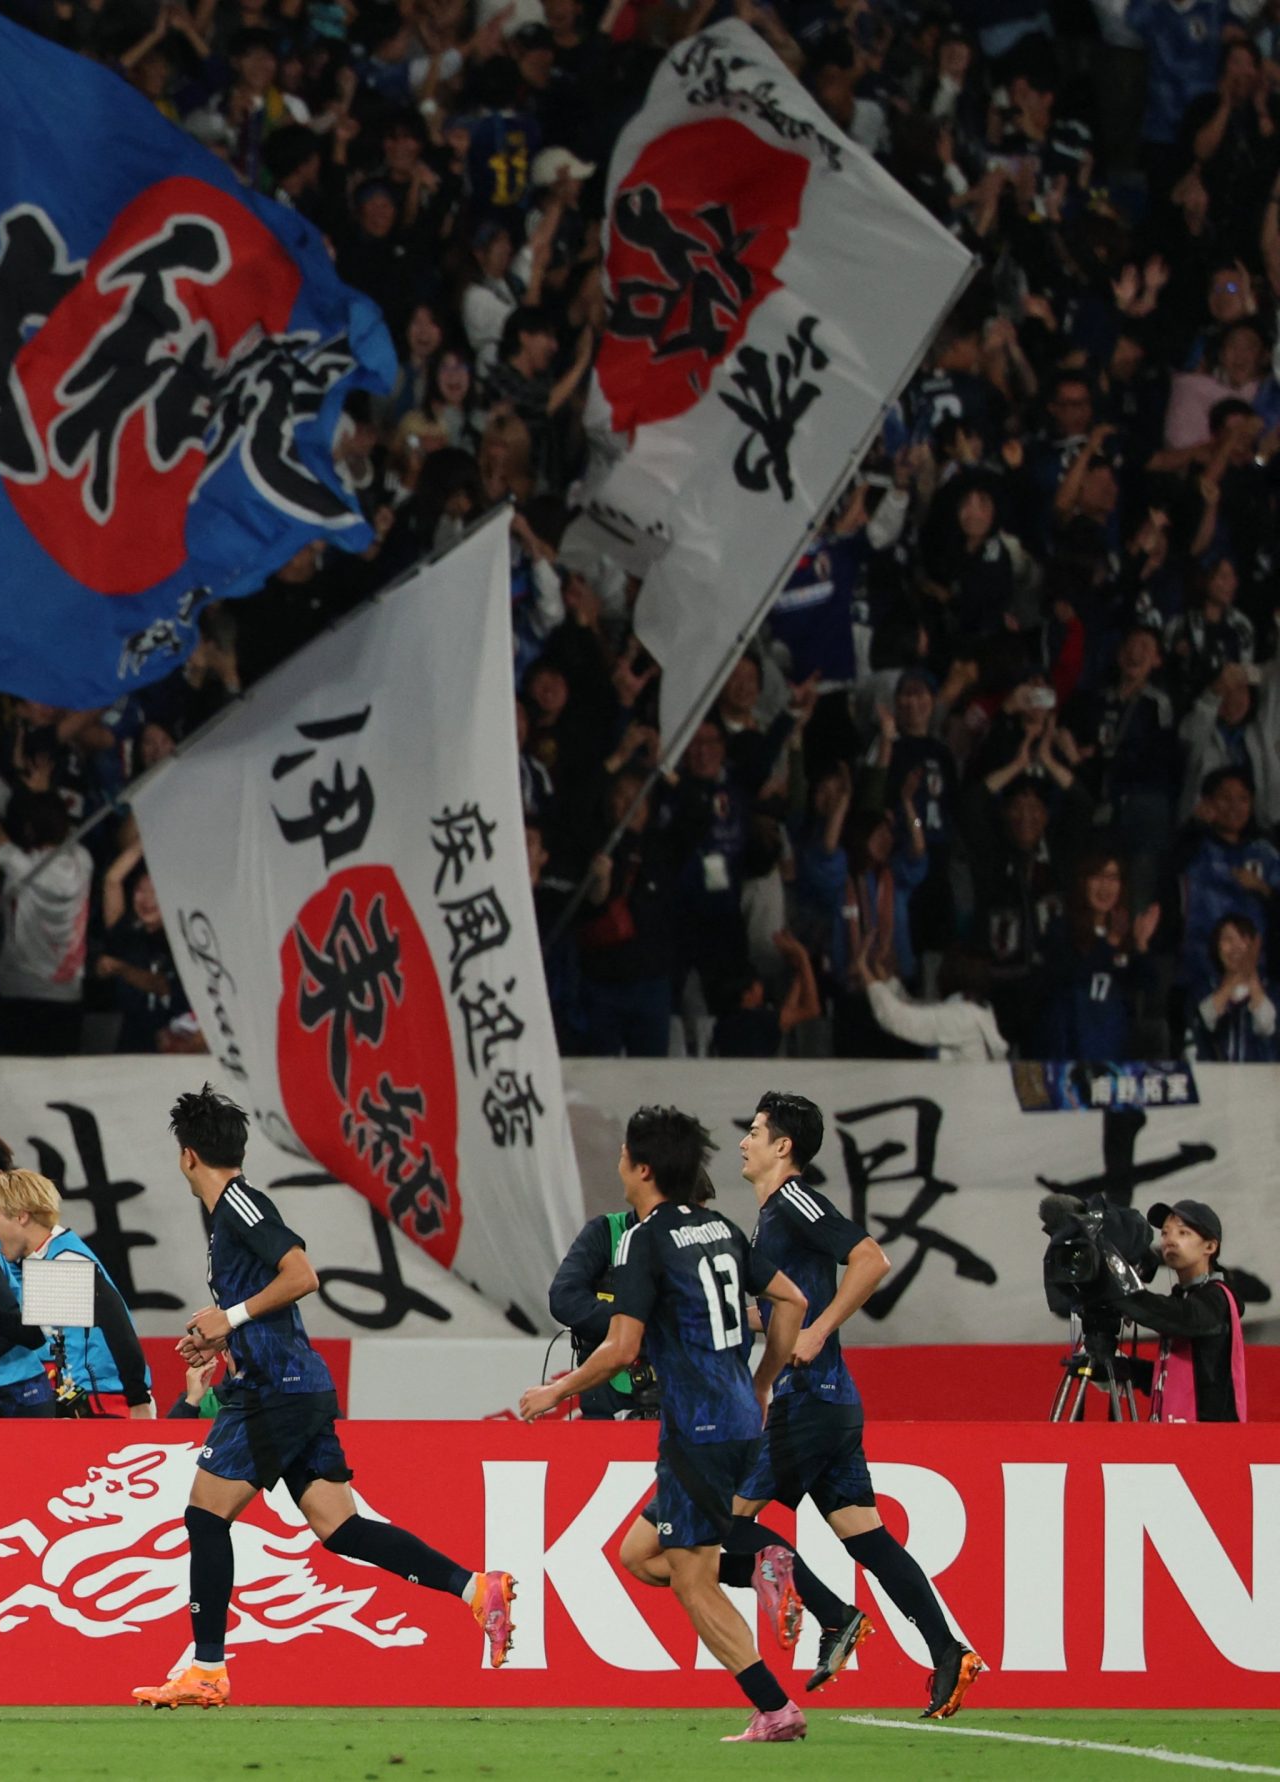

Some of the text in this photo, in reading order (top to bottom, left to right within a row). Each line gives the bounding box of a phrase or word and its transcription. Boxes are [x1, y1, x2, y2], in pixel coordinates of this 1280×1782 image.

[270, 703, 451, 1240] 伊東純
[430, 801, 546, 1148] 疾風迅雷
[697, 1252, 744, 1352] 13
[482, 1459, 1280, 1673] KRIN
